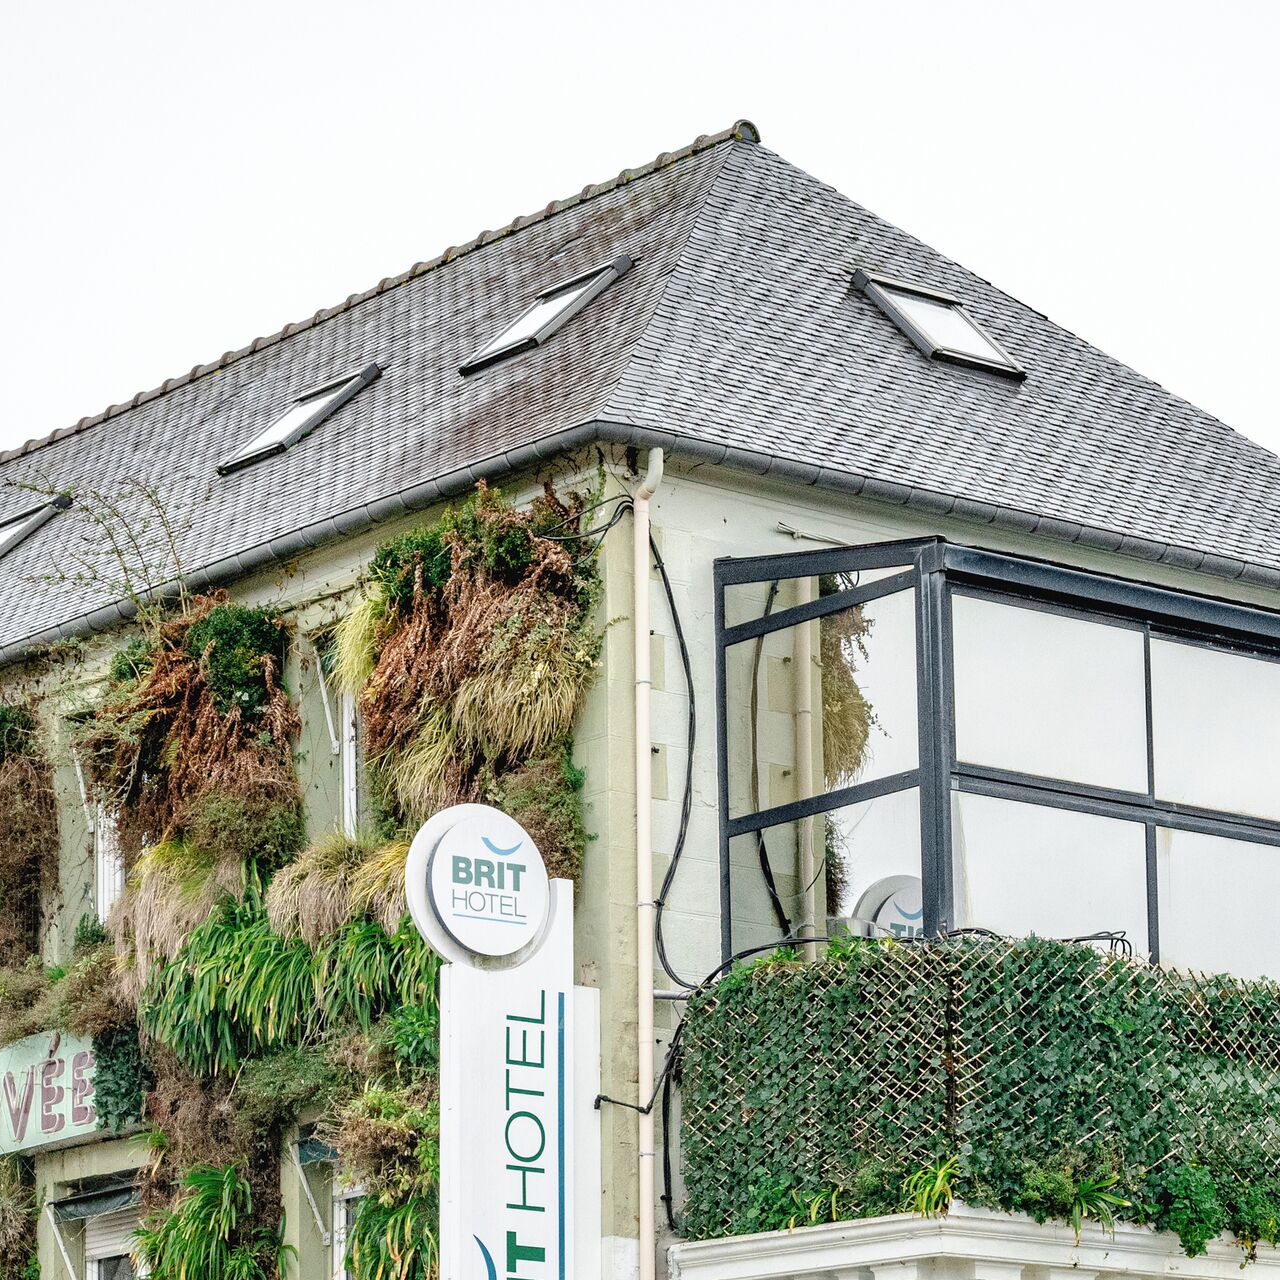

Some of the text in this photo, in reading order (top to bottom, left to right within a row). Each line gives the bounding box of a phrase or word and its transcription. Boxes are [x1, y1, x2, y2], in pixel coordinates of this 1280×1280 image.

[451, 855, 527, 892] BRIT
[451, 888, 527, 918] HOTEL
[505, 989, 546, 1213] HOTEL
